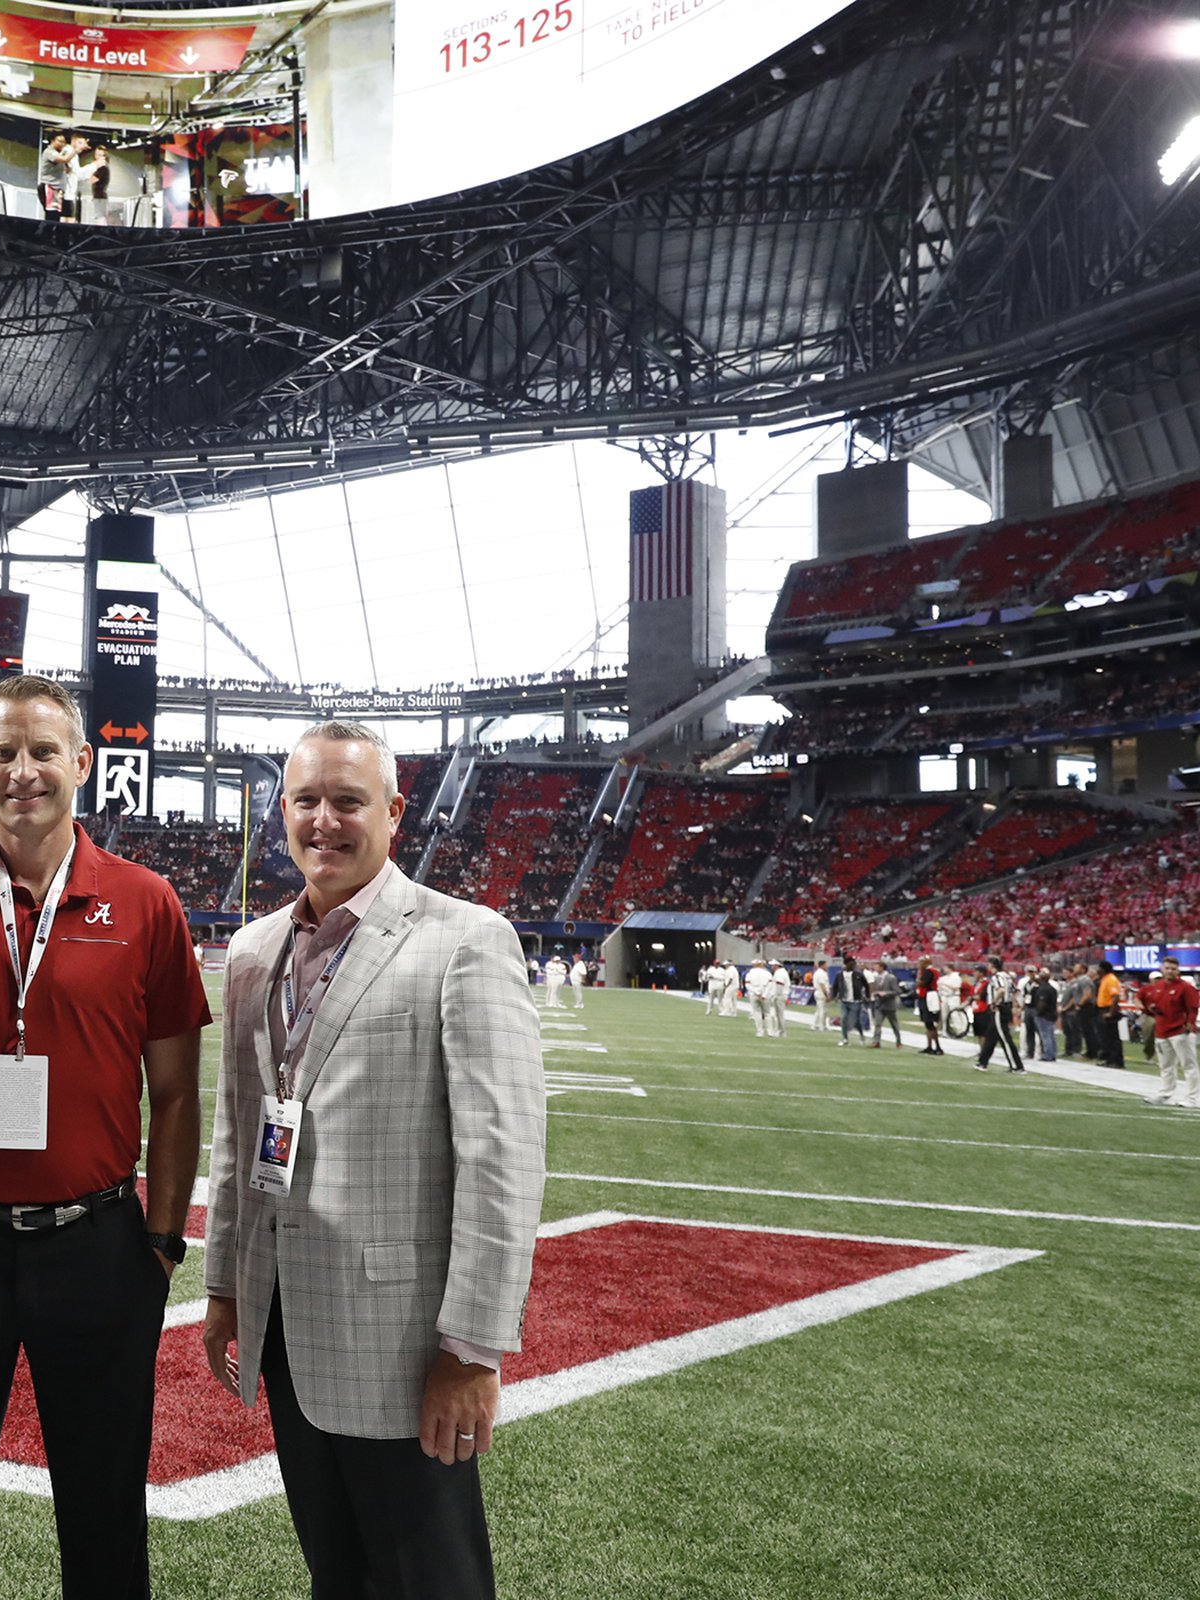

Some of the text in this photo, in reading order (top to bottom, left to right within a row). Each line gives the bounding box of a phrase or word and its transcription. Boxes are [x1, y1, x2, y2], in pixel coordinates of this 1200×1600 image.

[443, 10, 508, 41] SECTIONS
[606, 8, 644, 35] TAKE
[440, 0, 573, 73] 113-125
[621, 24, 643, 45] TO
[39, 40, 90, 62] Field
[94, 43, 148, 66] Level
[97, 642, 157, 656] EVACUATION
[114, 654, 140, 666] PLAN
[310, 693, 462, 708] Mercedes-Benz Stadium
[1125, 945, 1160, 969] DUKE
